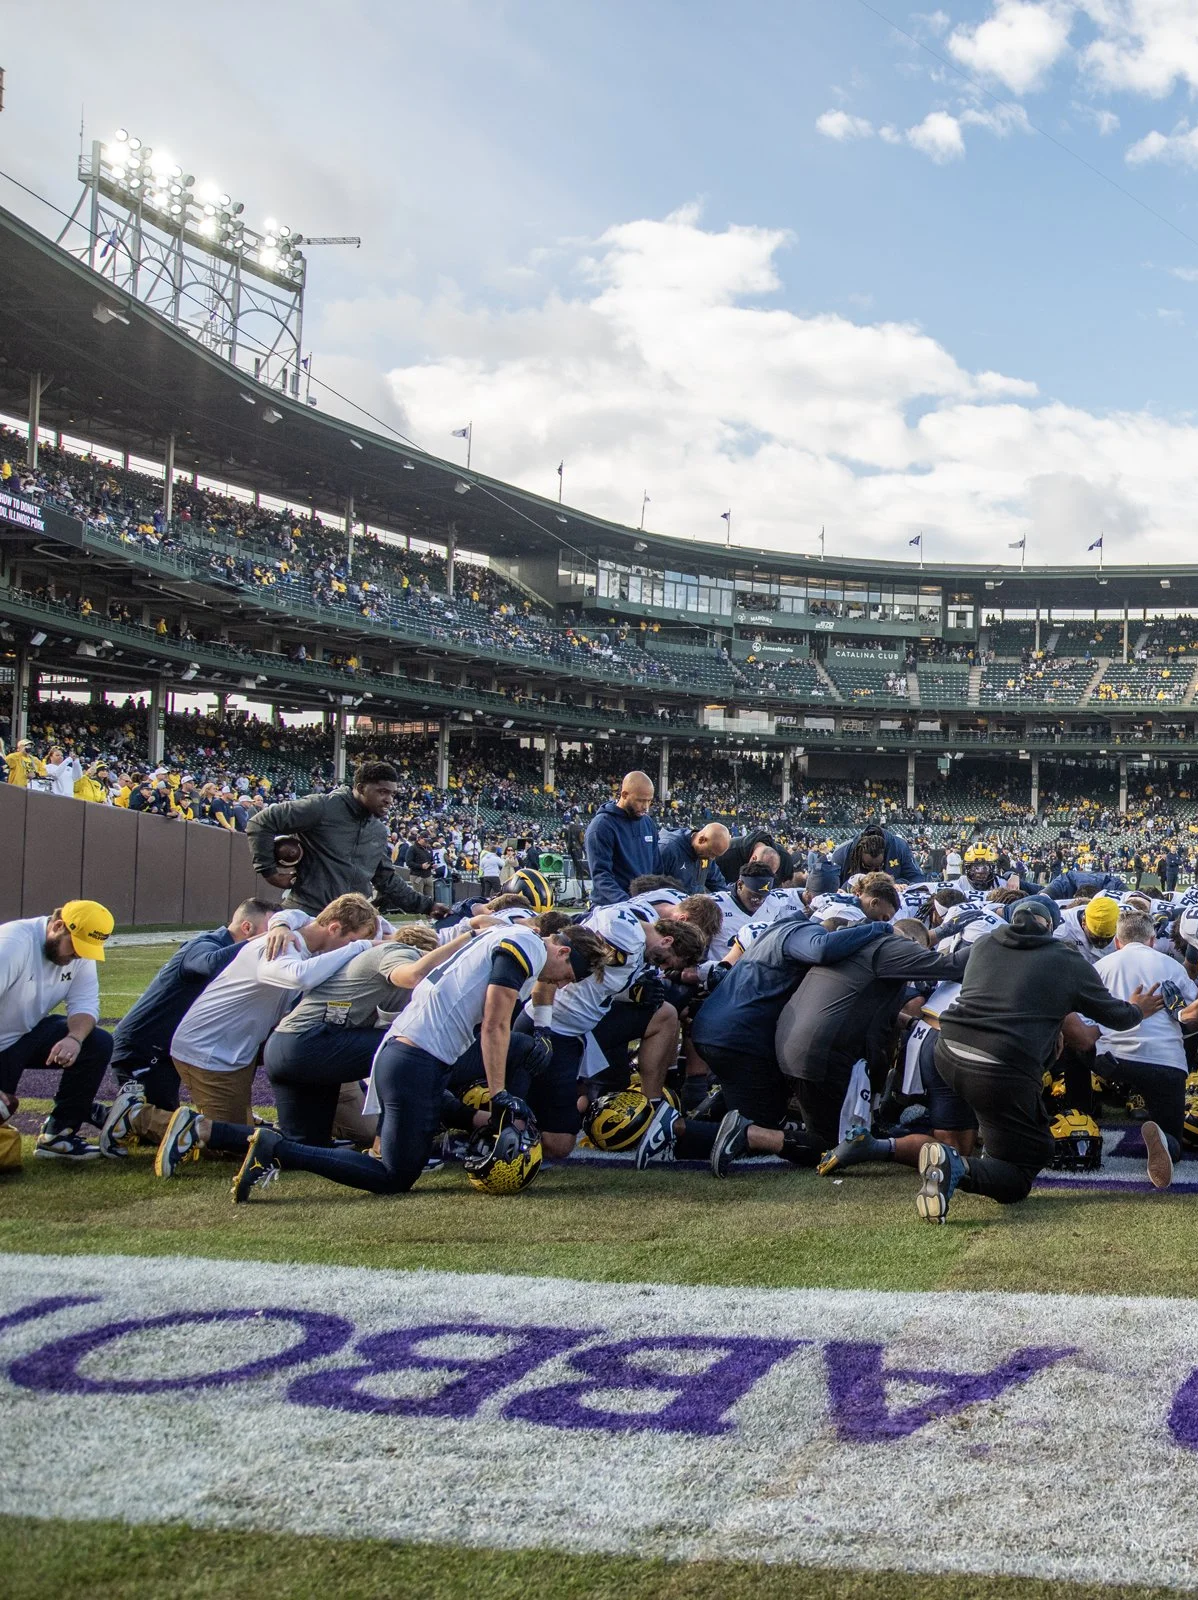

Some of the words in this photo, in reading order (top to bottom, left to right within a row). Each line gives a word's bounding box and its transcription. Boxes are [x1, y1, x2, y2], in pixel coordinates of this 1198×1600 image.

[0, 505, 8, 519] OU,
[762, 645, 794, 653] JamesHardie
[835, 650, 875, 659] CATALINA
[878, 652, 899, 660] CLUB
[60, 971, 72, 981] M
[912, 1027, 927, 1040] M
[0, 1295, 1078, 1443] ABBO
